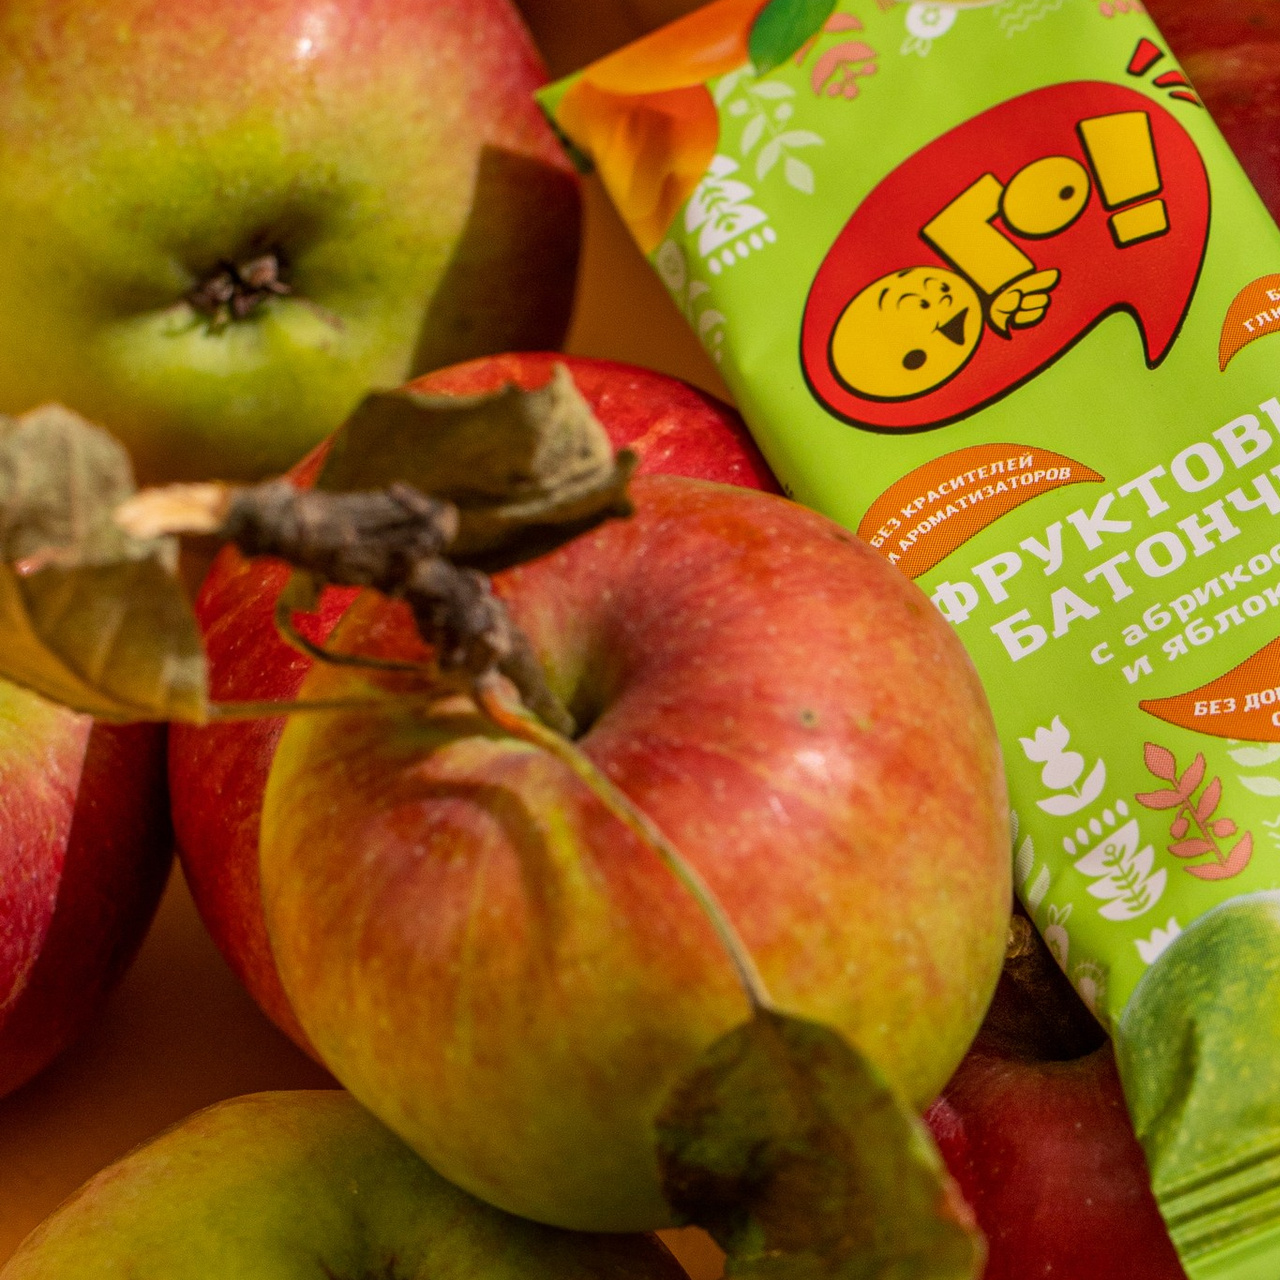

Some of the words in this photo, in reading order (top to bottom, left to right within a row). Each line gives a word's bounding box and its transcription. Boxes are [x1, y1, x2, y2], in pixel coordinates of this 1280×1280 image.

[870, 517, 901, 548] БЕЗ
[900, 451, 1034, 518] КРАСИТЕЛЕЙ
[898, 467, 1072, 552] АРОМАТИЗАТОРОВ
[1090, 641, 1115, 665] с
[1121, 654, 1153, 685] и
[1194, 697, 1237, 717] БЕЗ
